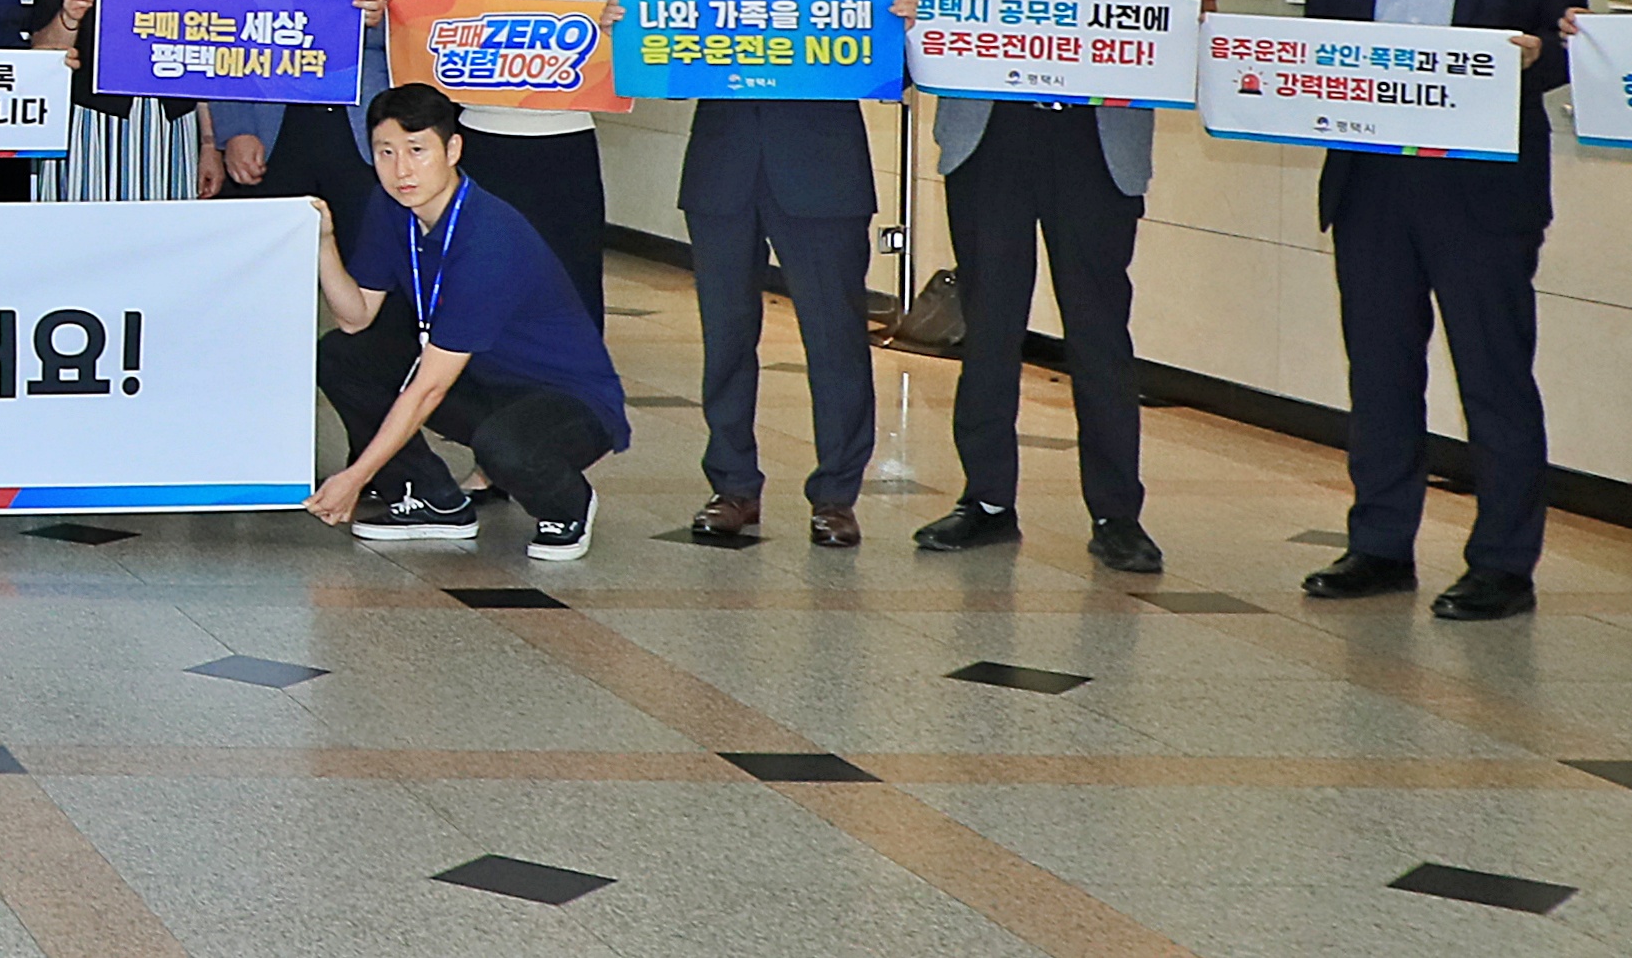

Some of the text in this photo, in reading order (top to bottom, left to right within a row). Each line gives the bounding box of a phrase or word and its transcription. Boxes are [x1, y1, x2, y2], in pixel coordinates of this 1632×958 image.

[133, 11, 314, 48] 부패 없는 세상,
[639, 0, 872, 30] 나와 가족을 위해
[999, 0, 1078, 27] 공무원
[1088, 3, 1170, 32] 사전에
[435, 20, 589, 52] 부패ZERO
[640, 35, 872, 65] 음주운전은 NO!
[922, 30, 1155, 65] 음주운전이란 없다!
[151, 43, 327, 78] 평택에서 시작
[440, 50, 572, 81] 청렴100%
[1210, 36, 1307, 64] 음주운전!
[1447, 51, 1495, 76] 같은
[746, 77, 775, 88] 평택시
[1028, 74, 1065, 86] 평택시
[1276, 73, 1457, 108] 강력범죄입니다.
[1336, 121, 1376, 134] 평택시
